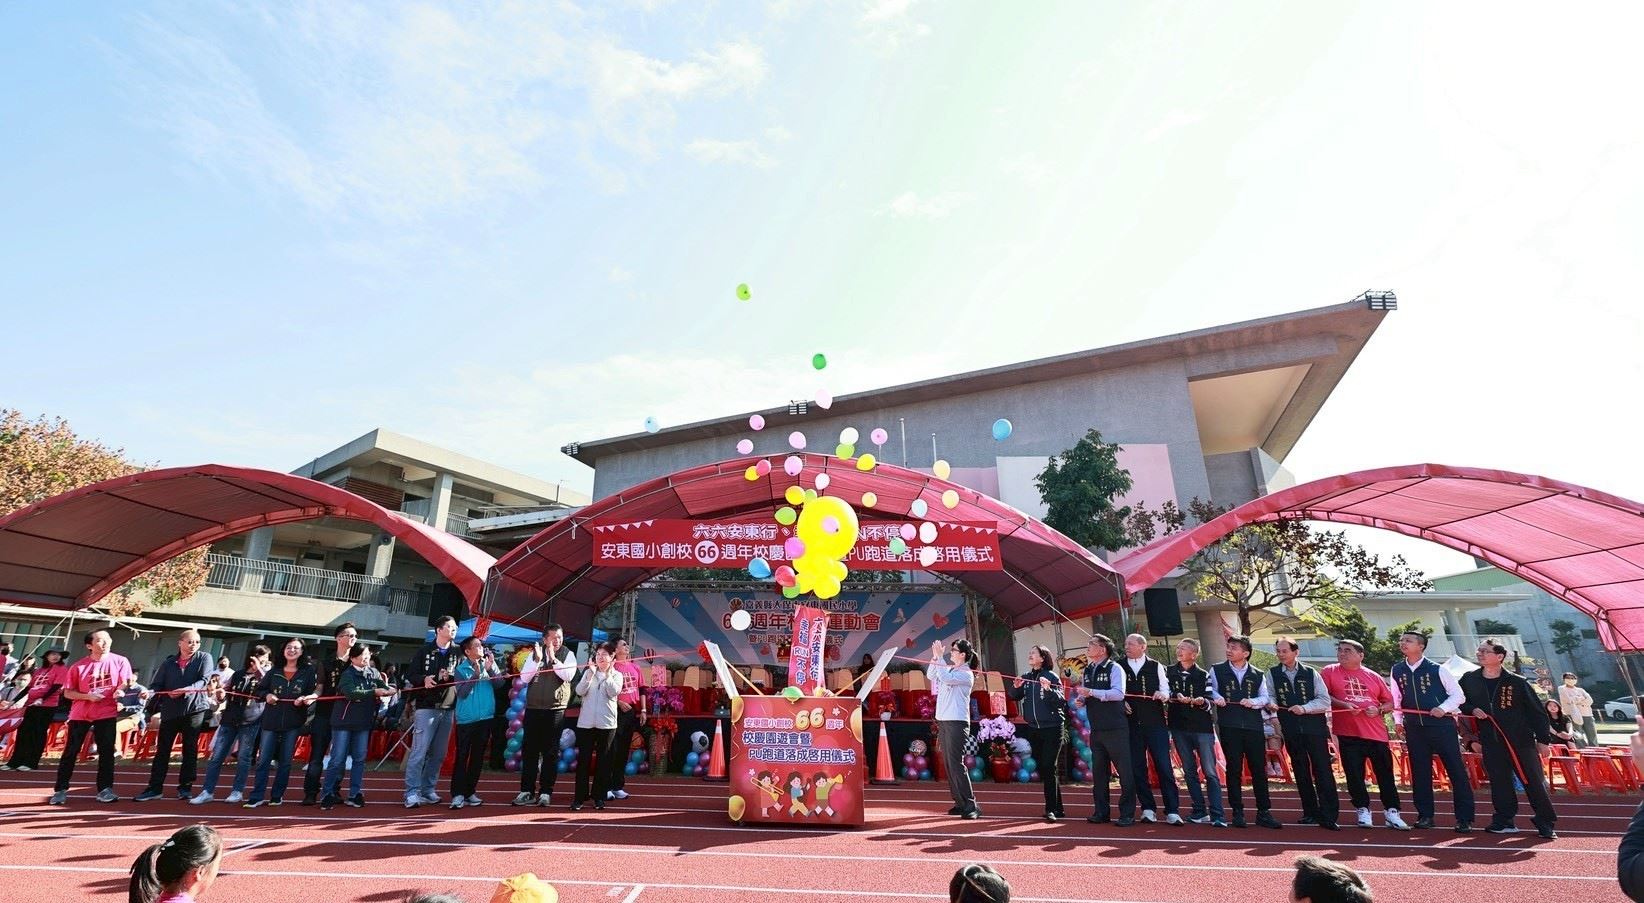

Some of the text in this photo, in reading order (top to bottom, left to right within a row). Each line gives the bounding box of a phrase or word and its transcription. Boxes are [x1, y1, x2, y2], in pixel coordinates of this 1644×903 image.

[722, 613, 880, 631] 6週年運動會
[810, 617, 824, 680] 六六安東行
[742, 732, 812, 746] 校慶園遊會暨
